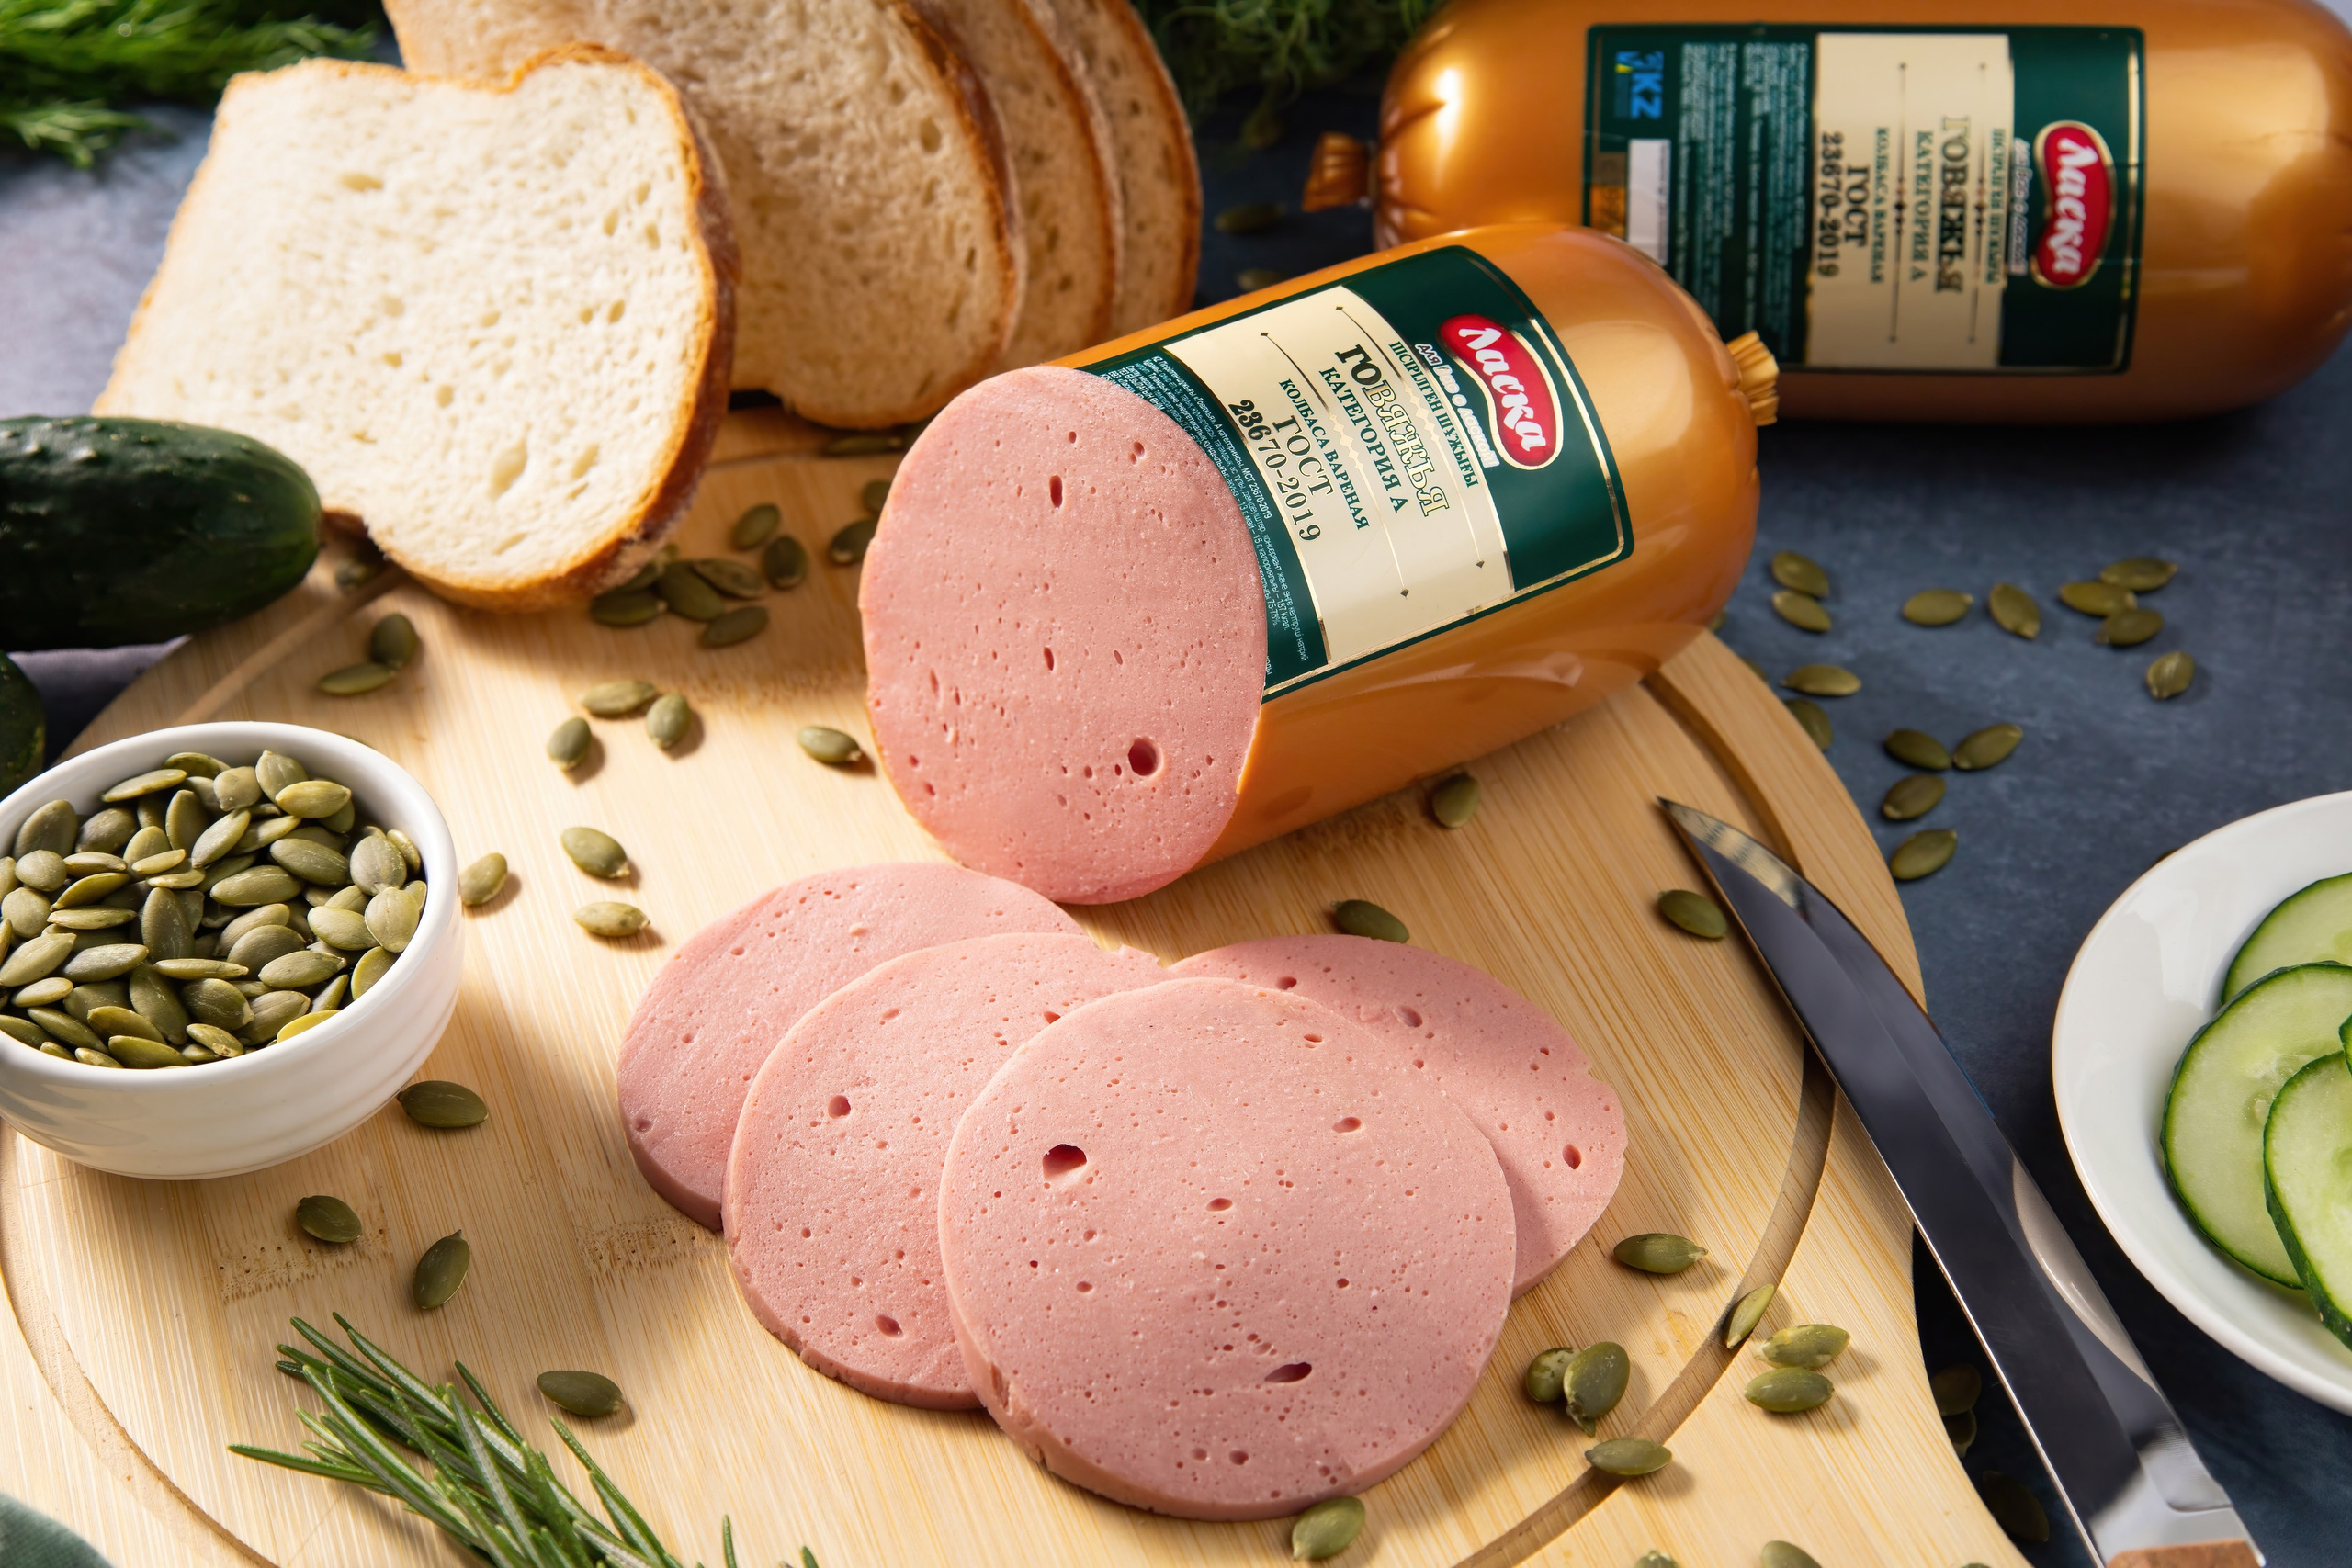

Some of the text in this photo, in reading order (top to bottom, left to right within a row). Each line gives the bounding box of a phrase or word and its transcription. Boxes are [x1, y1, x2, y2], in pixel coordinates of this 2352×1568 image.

[1816, 130, 1842, 278] 23670-2019
[1844, 164, 1870, 248] ГОСТ
[1870, 126, 1890, 284] КОЛБАСА ВАРЕНАЯ
[1910, 130, 1935, 281] КАТЕГОРИЯ А
[1935, 115, 1971, 294] ГОВЯЖЬЯ
[2046, 137, 2099, 275] Ласка
[1414, 344, 1443, 366] для
[1458, 328, 1546, 452] Ласка
[1228, 400, 1320, 540] 23670-2019
[1241, 468, 1255, 482] МСТ
[1249, 482, 1272, 519] 23670-2019
[1272, 415, 1333, 495] ГОСТ
[1279, 378, 1370, 530] КОЛБАСА ВАРЕНАЯ
[1318, 367, 1408, 513] КАТЕГОРИЯ А
[1334, 344, 1450, 517] ГОВЯЖЬЯ
[1253, 535, 1262, 544] 15
[1277, 599, 1287, 611] 187
